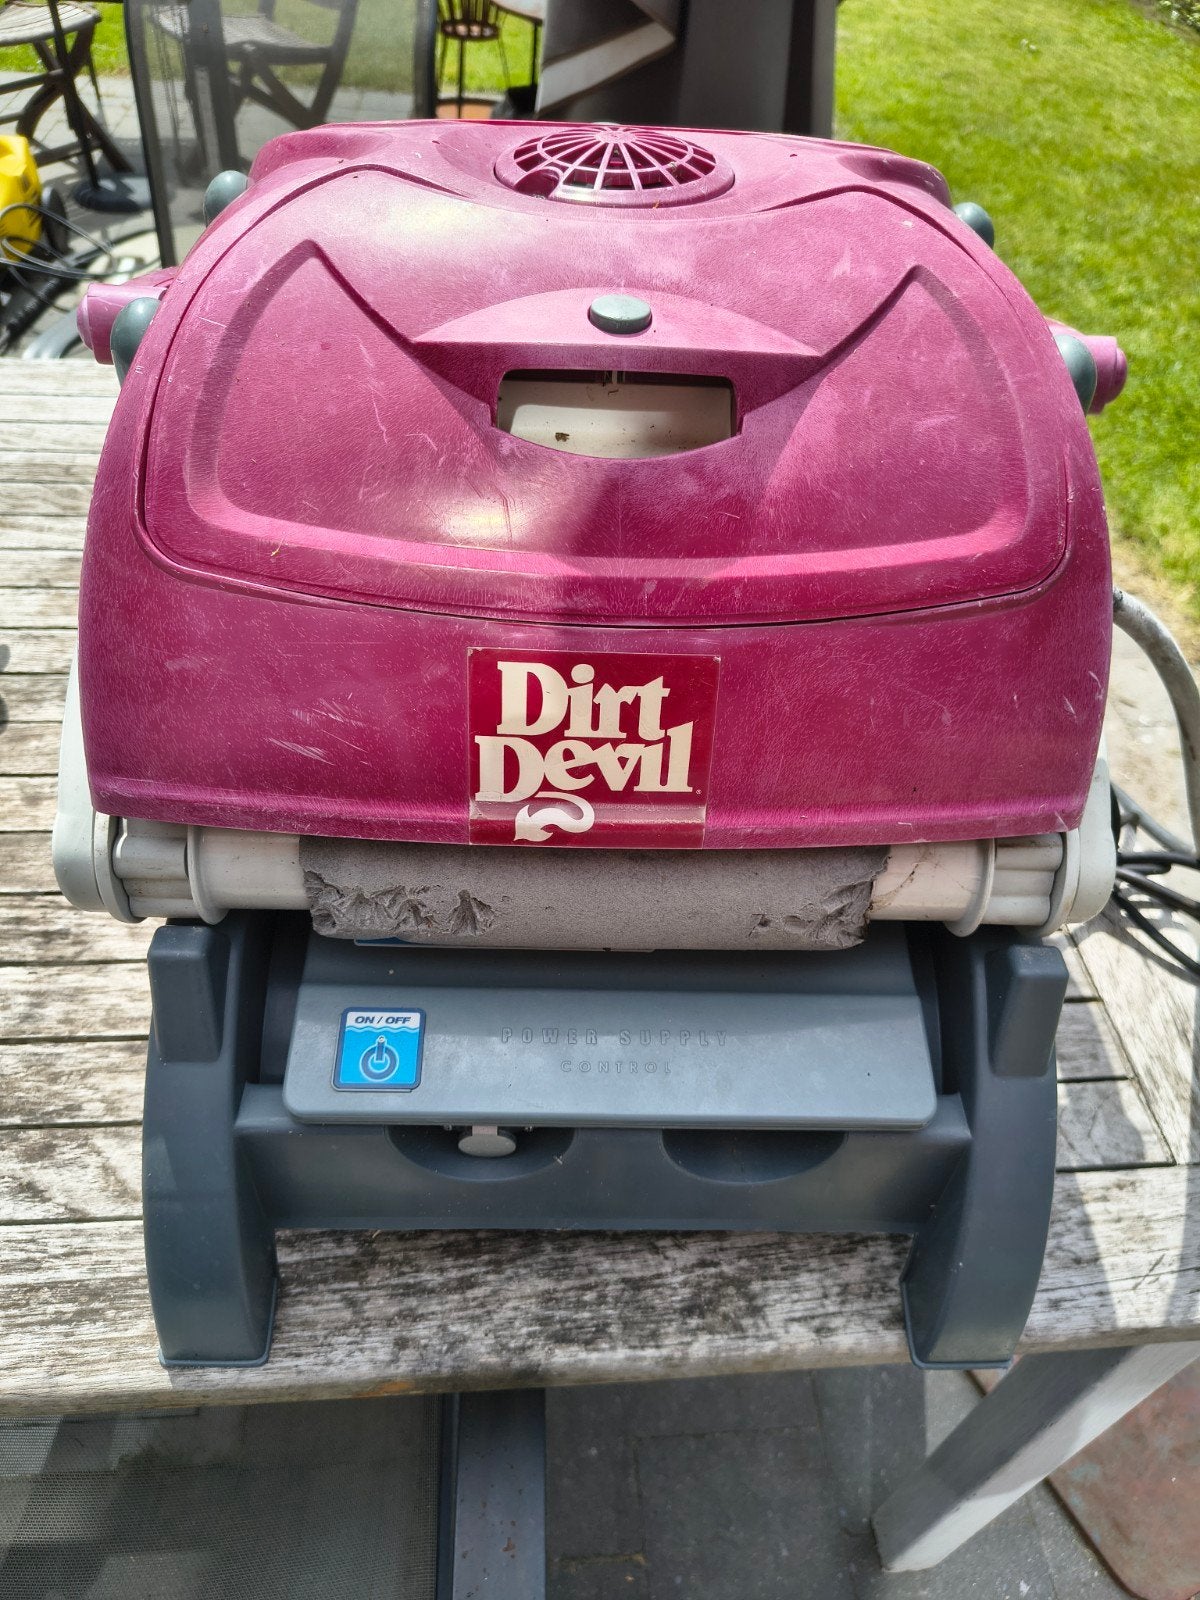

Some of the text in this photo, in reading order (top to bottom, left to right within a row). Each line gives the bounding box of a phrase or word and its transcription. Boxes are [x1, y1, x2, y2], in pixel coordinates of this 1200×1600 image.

[497, 660, 671, 741] Dirt
[474, 720, 694, 803] Devil
[354, 1016, 375, 1024] ON
[385, 1016, 411, 1025] OFF
[501, 1027, 727, 1046] POWER SUPPLY
[560, 1060, 671, 1074] CONTROL
